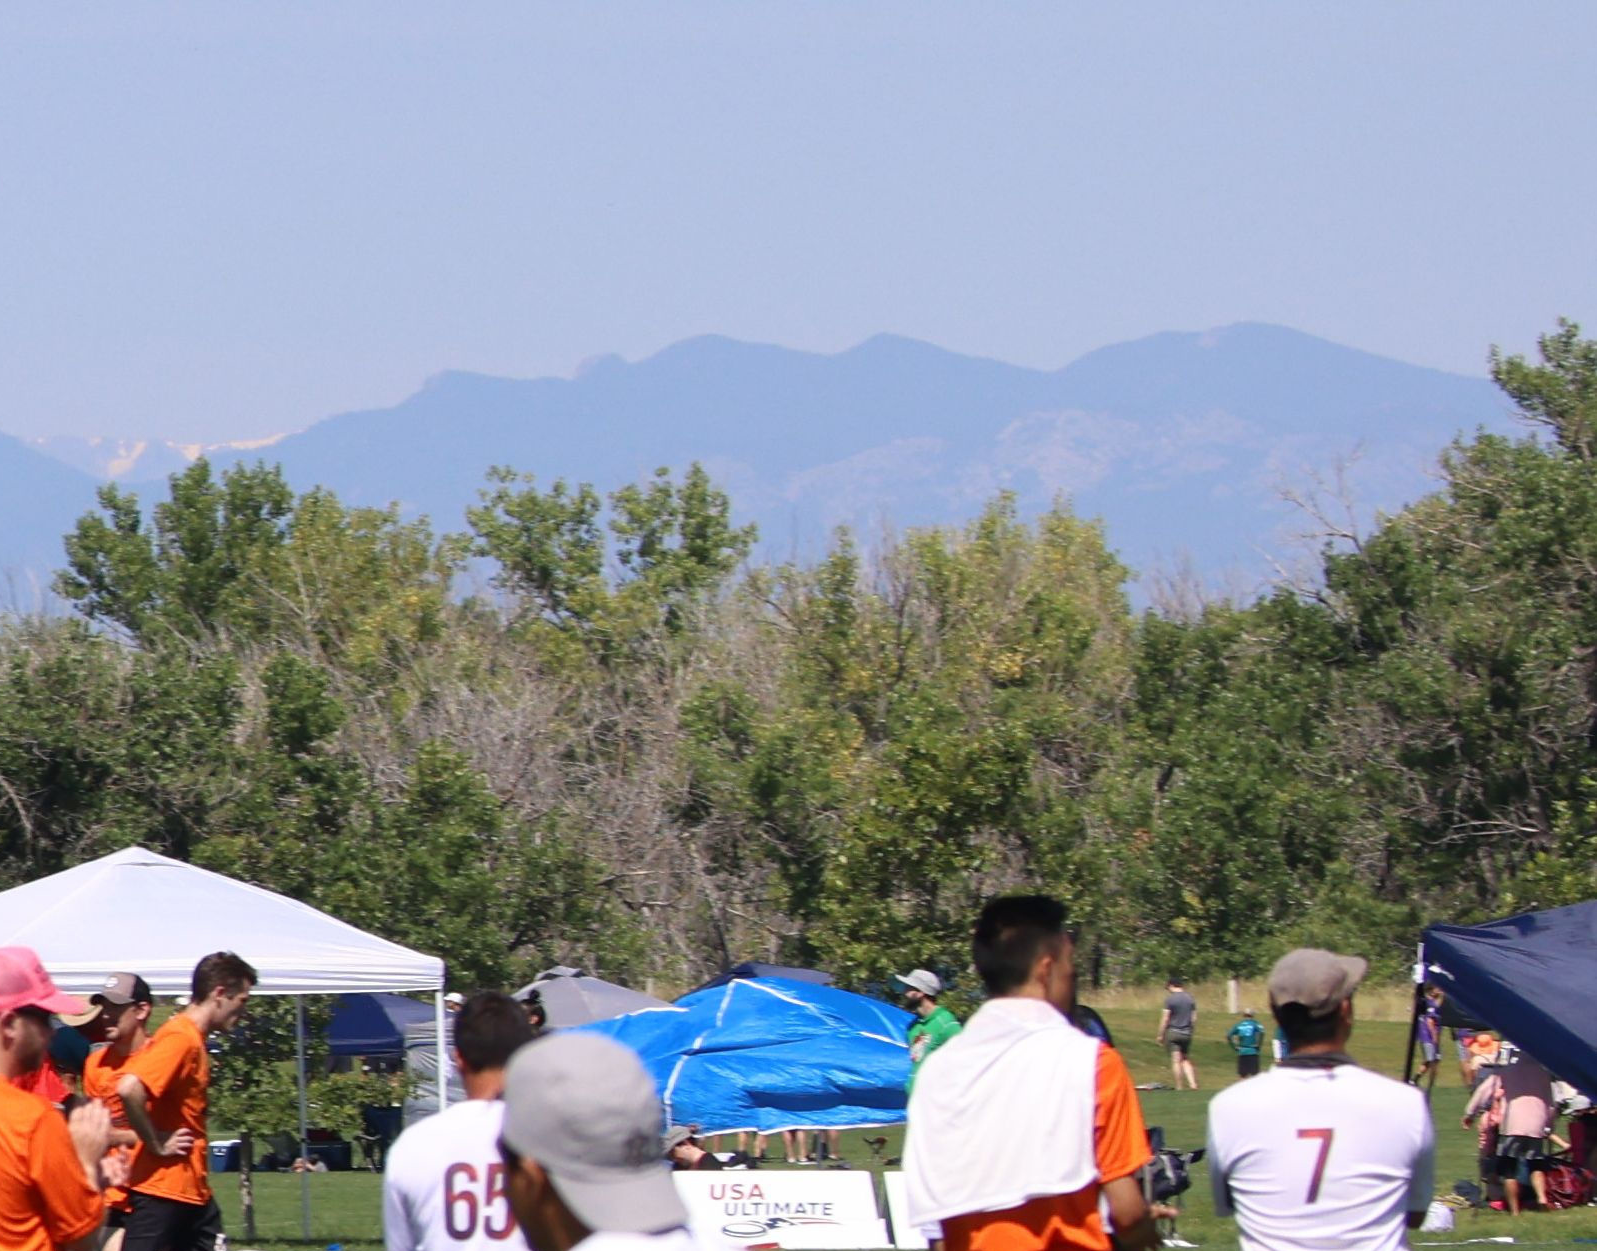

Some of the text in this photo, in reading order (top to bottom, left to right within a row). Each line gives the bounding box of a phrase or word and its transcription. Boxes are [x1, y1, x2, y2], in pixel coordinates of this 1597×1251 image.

[1296, 1127, 1333, 1204] 7
[444, 1162, 515, 1240] 65
[710, 1184, 764, 1201] USA
[725, 1203, 834, 1216] ULTIMATE
